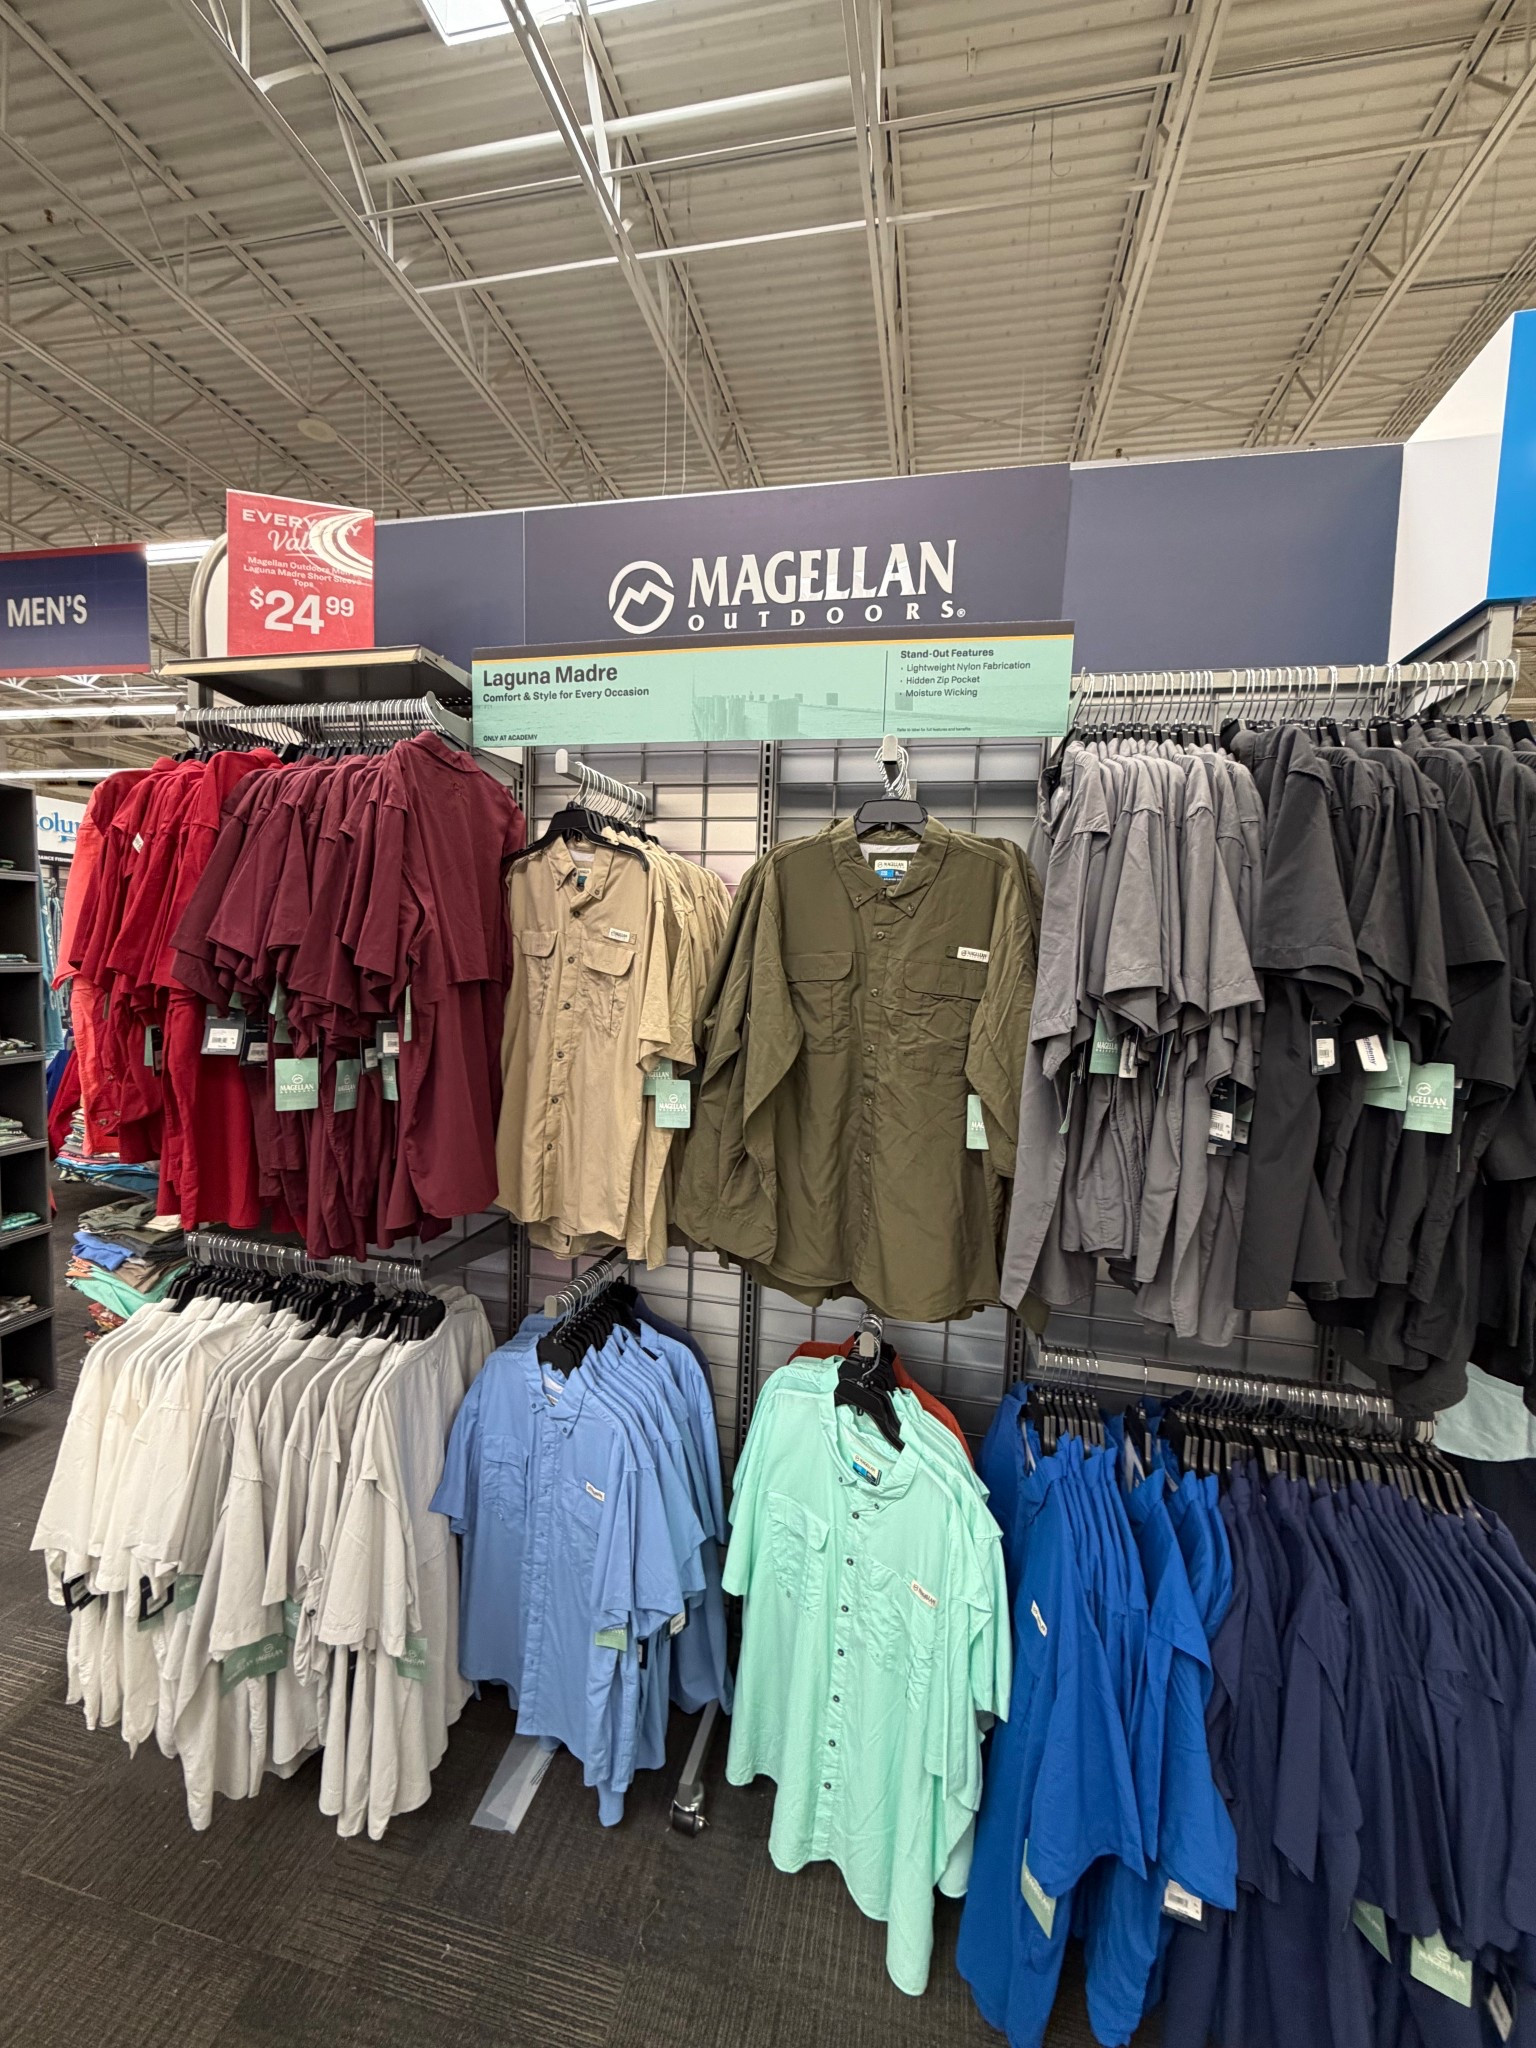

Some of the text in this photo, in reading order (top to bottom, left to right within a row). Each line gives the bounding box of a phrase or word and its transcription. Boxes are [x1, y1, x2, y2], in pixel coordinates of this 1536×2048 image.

[242, 508, 362, 537] EVERYY
[267, 530, 314, 552] Val
[247, 556, 289, 568] Magellan
[243, 564, 277, 575] Laguna
[277, 568, 307, 579] Madre
[307, 571, 332, 582] Short
[688, 539, 956, 608] MAGELLAN
[293, 578, 314, 588] Tops
[7, 594, 88, 628] MEN'S
[900, 648, 994, 659] Stand-Out Features
[906, 660, 1031, 674] Lightweight Nylon Fabrication
[483, 663, 618, 690] Laguna Madre
[906, 675, 981, 685] Hidden Zip Pocket
[483, 686, 650, 703] Comfort & Style for Every Occasion
[905, 687, 978, 698] Moisture Wicking
[1096, 1041, 1118, 1049] MAGELLA
[280, 1083, 314, 1091] MAGELLAN
[1408, 1095, 1447, 1106] AGELLAN
